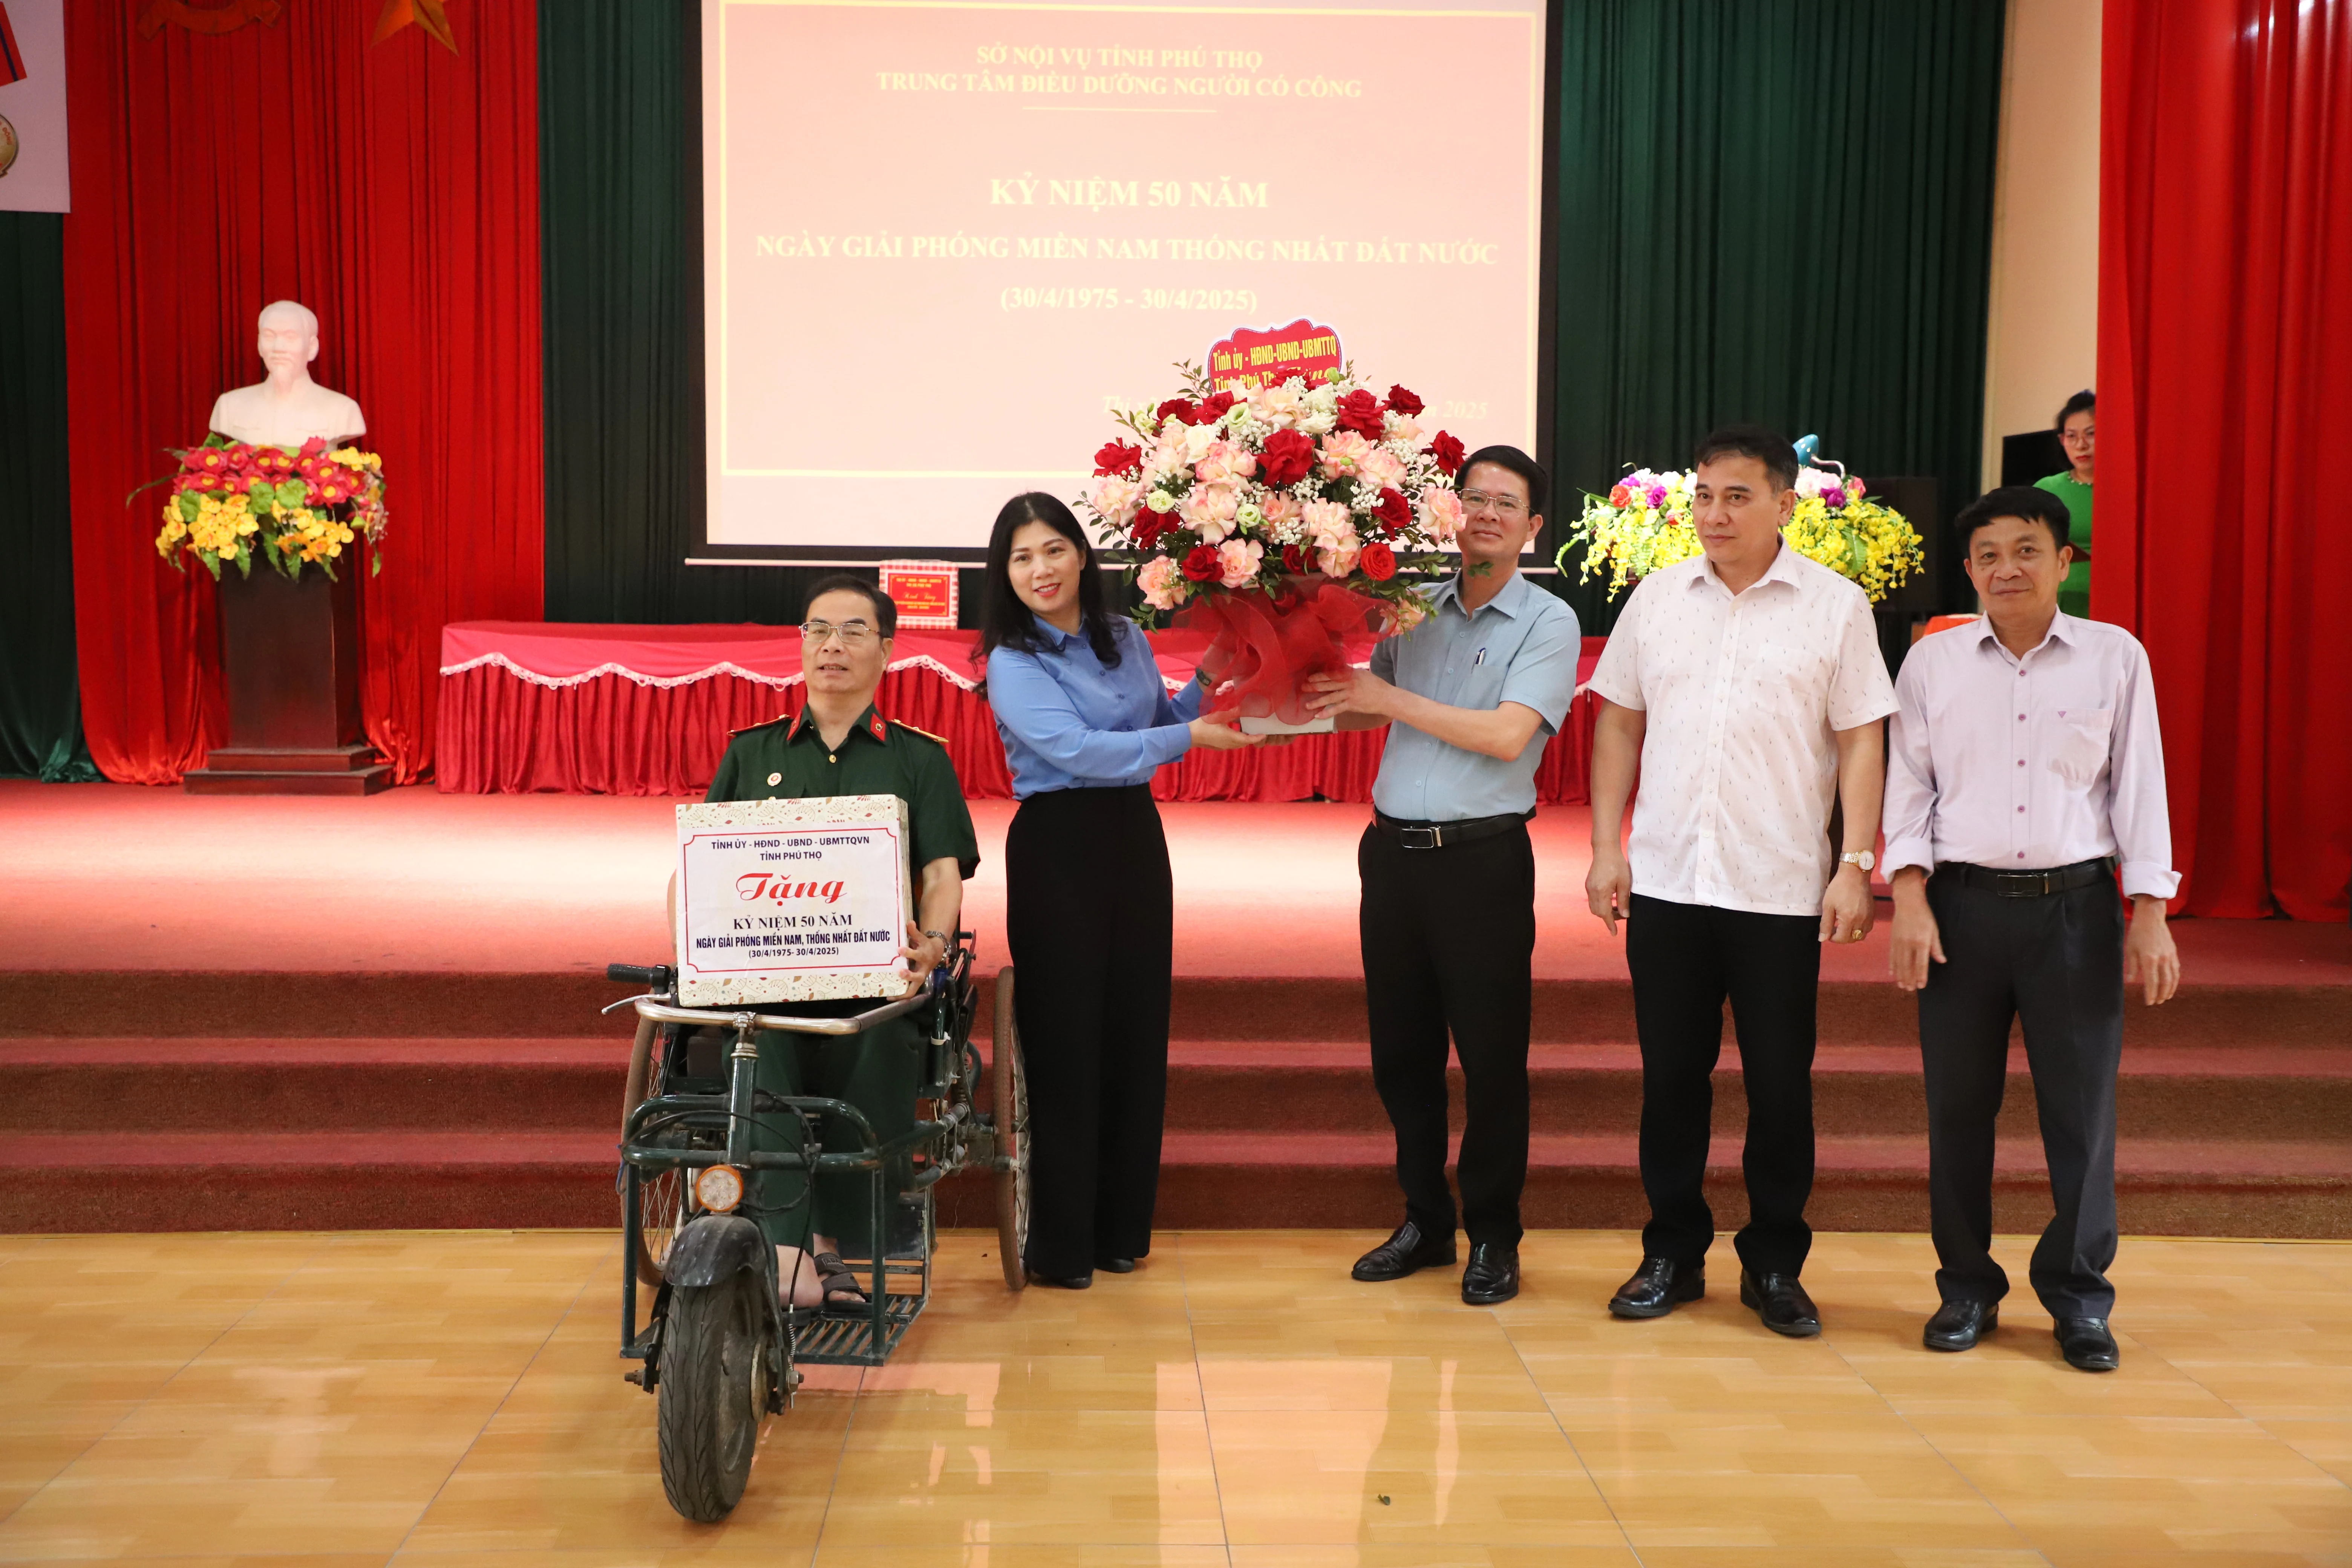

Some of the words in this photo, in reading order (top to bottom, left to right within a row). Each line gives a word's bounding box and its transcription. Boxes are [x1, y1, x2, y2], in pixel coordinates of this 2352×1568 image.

[977, 41, 1008, 64] SỞ
[1012, 44, 1054, 70] NỘI
[1060, 48, 1092, 70] VỤ
[1160, 45, 1207, 67] PHÚ
[1212, 50, 1262, 74] THỌ
[876, 71, 957, 92] TRUNG
[962, 69, 1014, 92] TÂM
[1083, 72, 1167, 95] DƯỠNG
[1255, 74, 1289, 97] CÓ
[1294, 75, 1362, 98] CÔNG
[990, 171, 1040, 205] KỶ
[1048, 175, 1140, 212] NIỆM
[1148, 181, 1181, 207] 50
[1189, 175, 1269, 208] NĂM
[755, 228, 836, 258] NGÀY
[842, 229, 903, 258] GIẢI
[911, 229, 1010, 259] PHÓNG
[1096, 238, 1159, 260] NAM
[1000, 286, 1119, 312] (30/4/1975
[1139, 288, 1258, 315] 30/4/2025)
[1213, 347, 1231, 372] Tỉnh
[1233, 347, 1243, 371] ủy
[1250, 335, 1337, 366] HĐND-UBND-UBMTTQ
[1442, 400, 1488, 420] 2025
[712, 839, 732, 849] TỈNH
[735, 839, 746, 848] ỦY
[754, 839, 780, 848] HĐND
[787, 838, 812, 847] UBND
[820, 836, 870, 845] UBMTTQVN
[760, 851, 781, 861] TỈNH
[784, 850, 801, 860] PHÚ
[803, 851, 822, 861] THỌ
[736, 873, 847, 906] Tặng
[733, 915, 754, 929] KỶ
[758, 915, 797, 931] NIỆM
[801, 916, 815, 927] 50
[819, 912, 853, 926] NĂM
[697, 936, 716, 948] NGÀY
[719, 934, 733, 948] GIẢI
[736, 934, 760, 947] PHÓNG
[785, 934, 804, 946] NAM,
[806, 930, 830, 944] THỐNG
[833, 929, 851, 943] NHẤT
[854, 928, 867, 942] ĐẤT
[870, 929, 890, 942] NƯỚC
[749, 949, 794, 959] (30/4/1975-
[796, 947, 839, 956] 30/4/2025)
